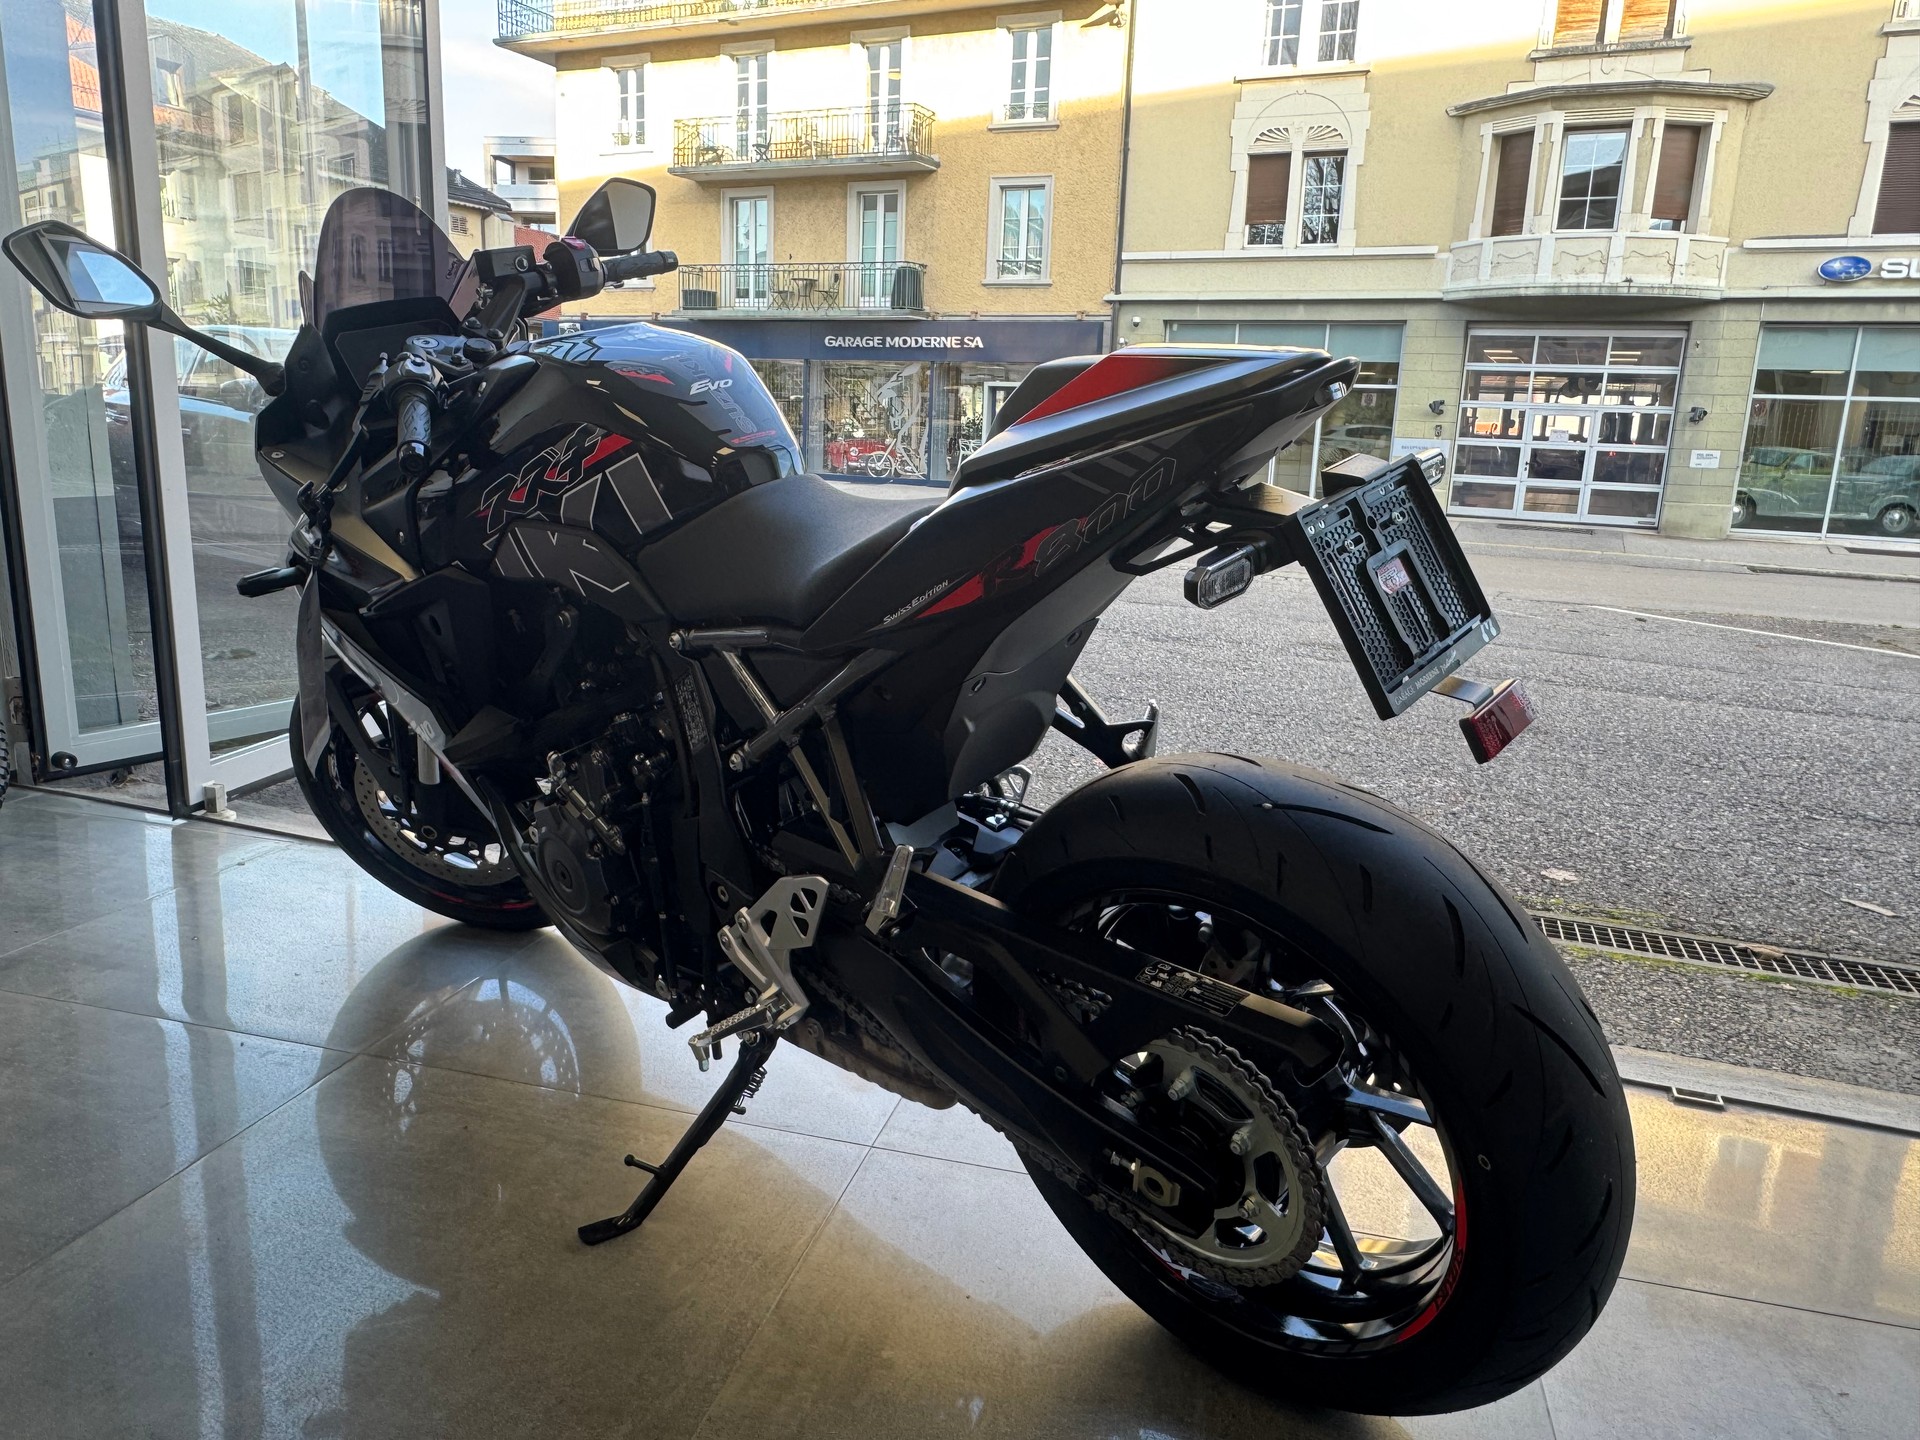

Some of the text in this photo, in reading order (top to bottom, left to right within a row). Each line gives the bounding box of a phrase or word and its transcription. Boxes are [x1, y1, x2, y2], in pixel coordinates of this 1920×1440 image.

[824, 335, 984, 348] GARAGE MODERNE SA
